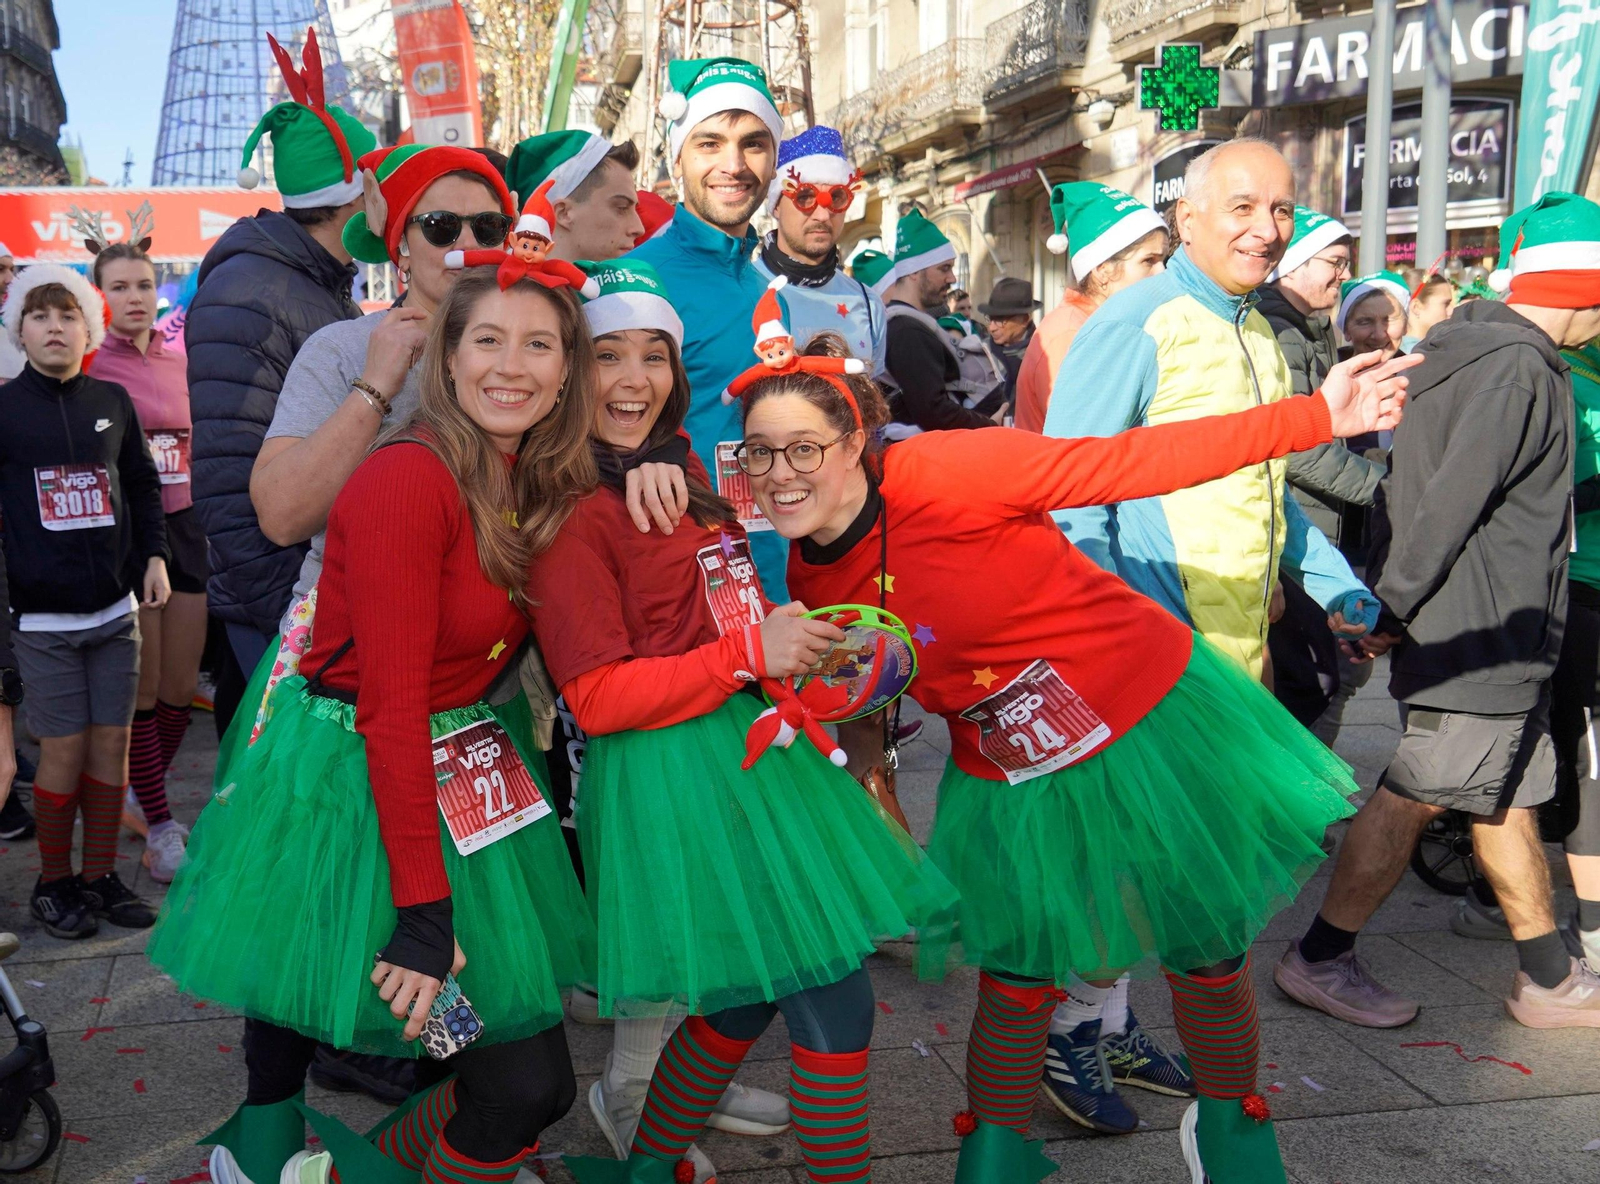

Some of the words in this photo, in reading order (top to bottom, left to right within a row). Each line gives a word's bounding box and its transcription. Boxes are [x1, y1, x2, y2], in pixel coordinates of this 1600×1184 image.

[1353, 128, 1499, 169] FRMCIA
[1477, 168, 1488, 184] 4
[61, 475, 97, 490] vigo
[53, 489, 104, 518] 3018
[726, 562, 754, 584] vigo
[996, 693, 1044, 730] vigo
[1008, 717, 1067, 763] 24
[458, 742, 502, 771] vigo
[473, 769, 515, 821] 22
